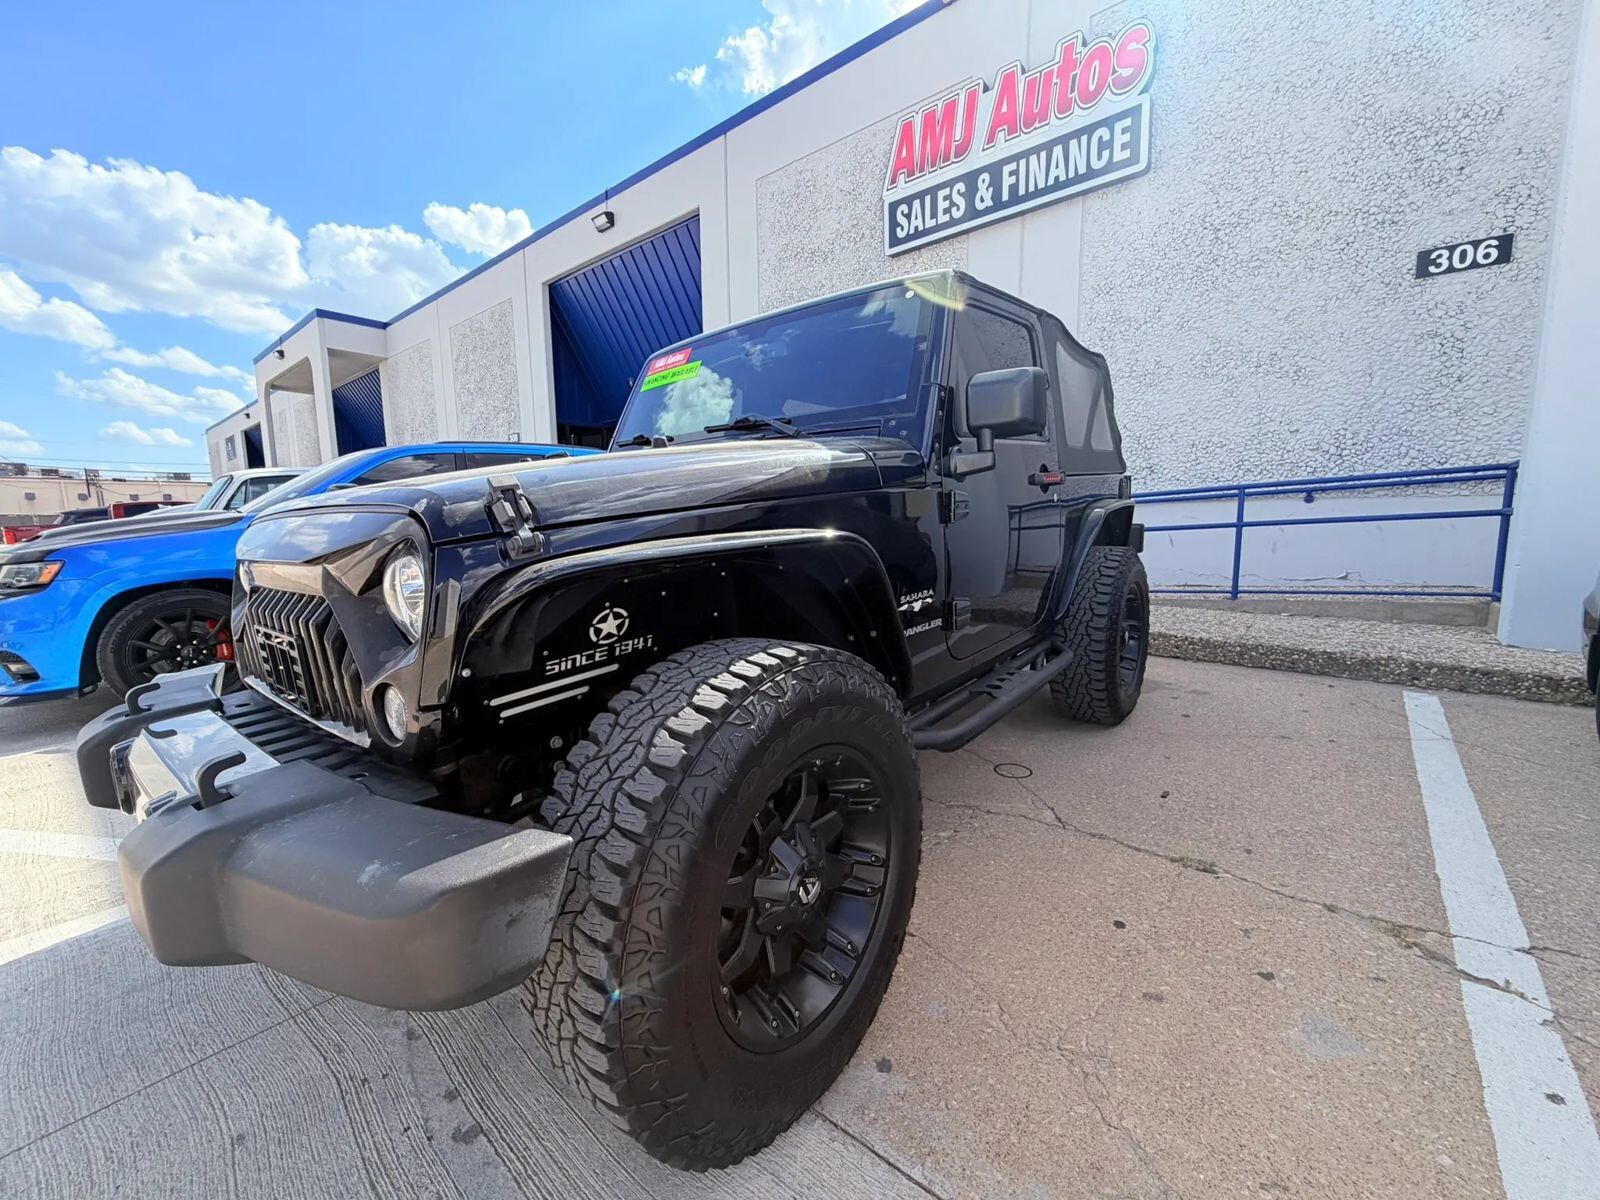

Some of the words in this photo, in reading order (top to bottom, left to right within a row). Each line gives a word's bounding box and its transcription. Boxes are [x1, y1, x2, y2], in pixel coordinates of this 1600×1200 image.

[886, 84, 981, 189] AMJ
[984, 25, 1151, 148] Autos
[896, 181, 966, 239] SALES
[975, 171, 994, 211] &
[1001, 117, 1132, 203] FINANCE
[1428, 239, 1500, 274] 306
[900, 588, 934, 604] SAHARA
[614, 634, 653, 657] 1941
